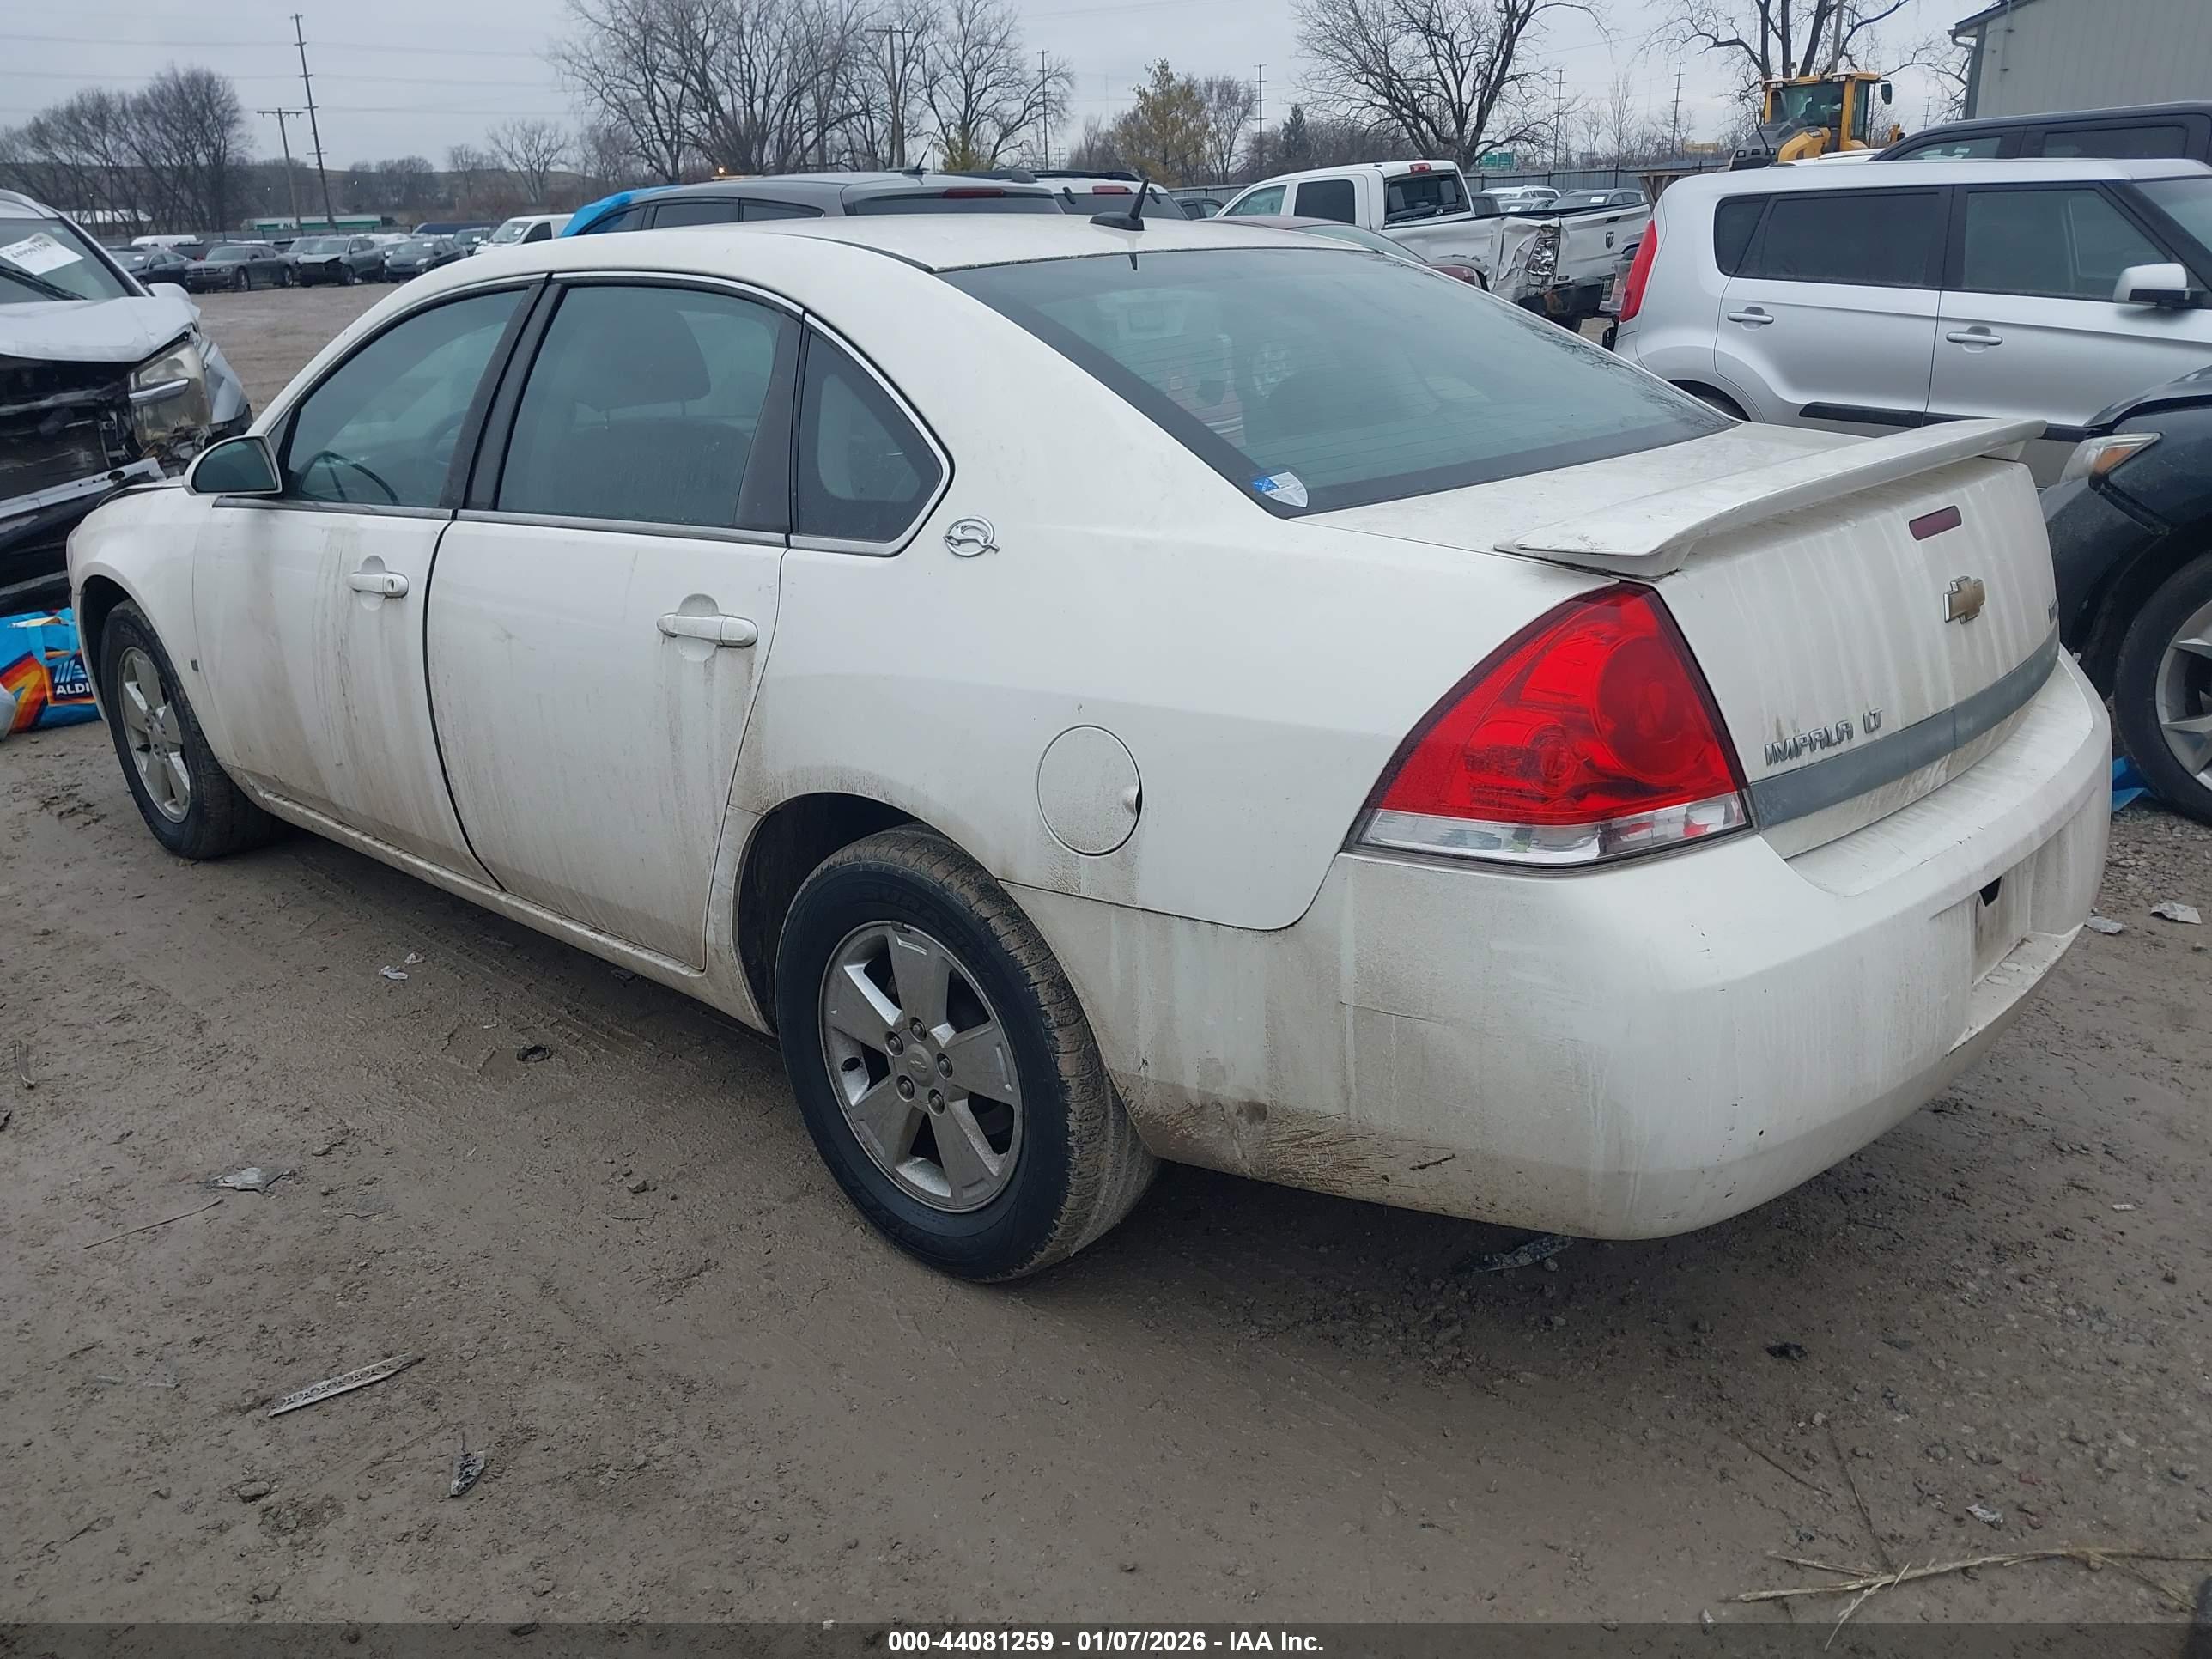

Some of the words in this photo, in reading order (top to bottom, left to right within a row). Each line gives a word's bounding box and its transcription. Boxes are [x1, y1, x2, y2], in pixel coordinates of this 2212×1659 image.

[56, 683, 91, 696] ALDI
[1764, 720, 1854, 766] IMPALA
[1862, 708, 1883, 734] LT
